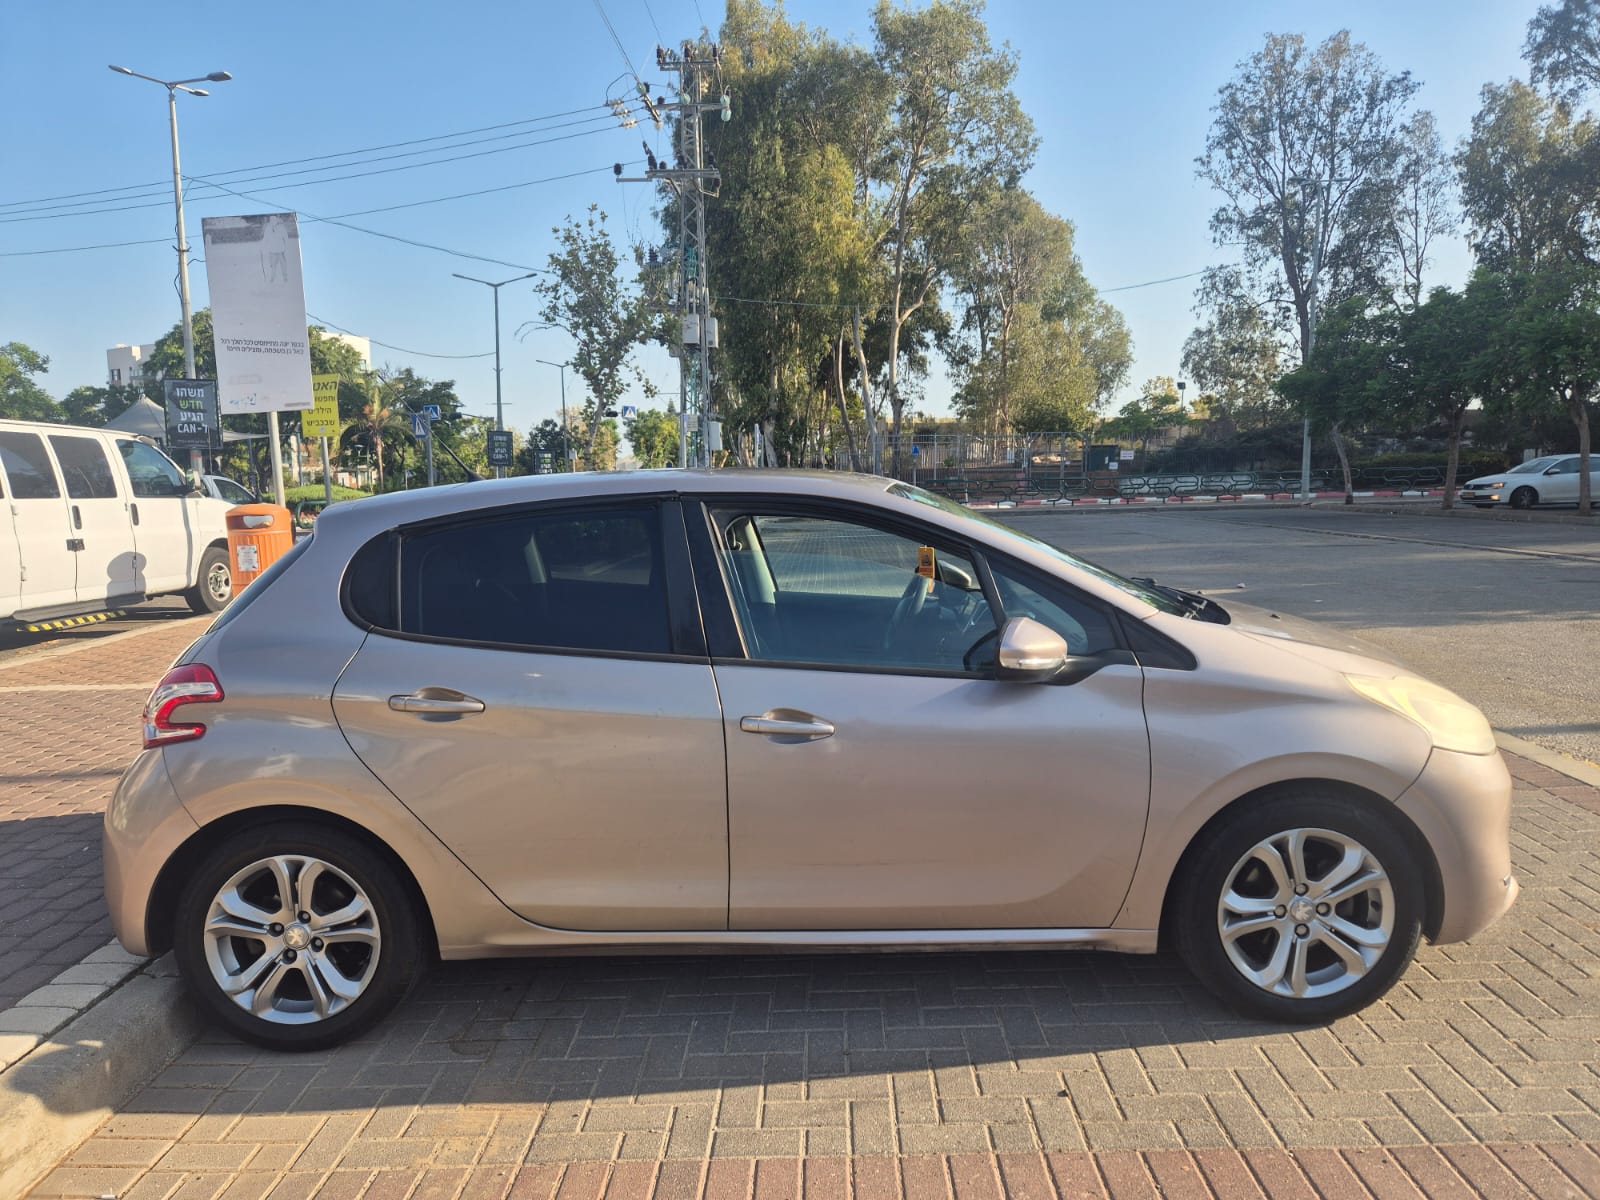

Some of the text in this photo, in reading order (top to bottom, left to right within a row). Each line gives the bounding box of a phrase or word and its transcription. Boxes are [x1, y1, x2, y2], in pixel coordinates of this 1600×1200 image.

[313, 381, 337, 391] האט
[176, 387, 204, 398] משהו
[180, 400, 203, 410] חדש
[180, 411, 204, 422] הגיע
